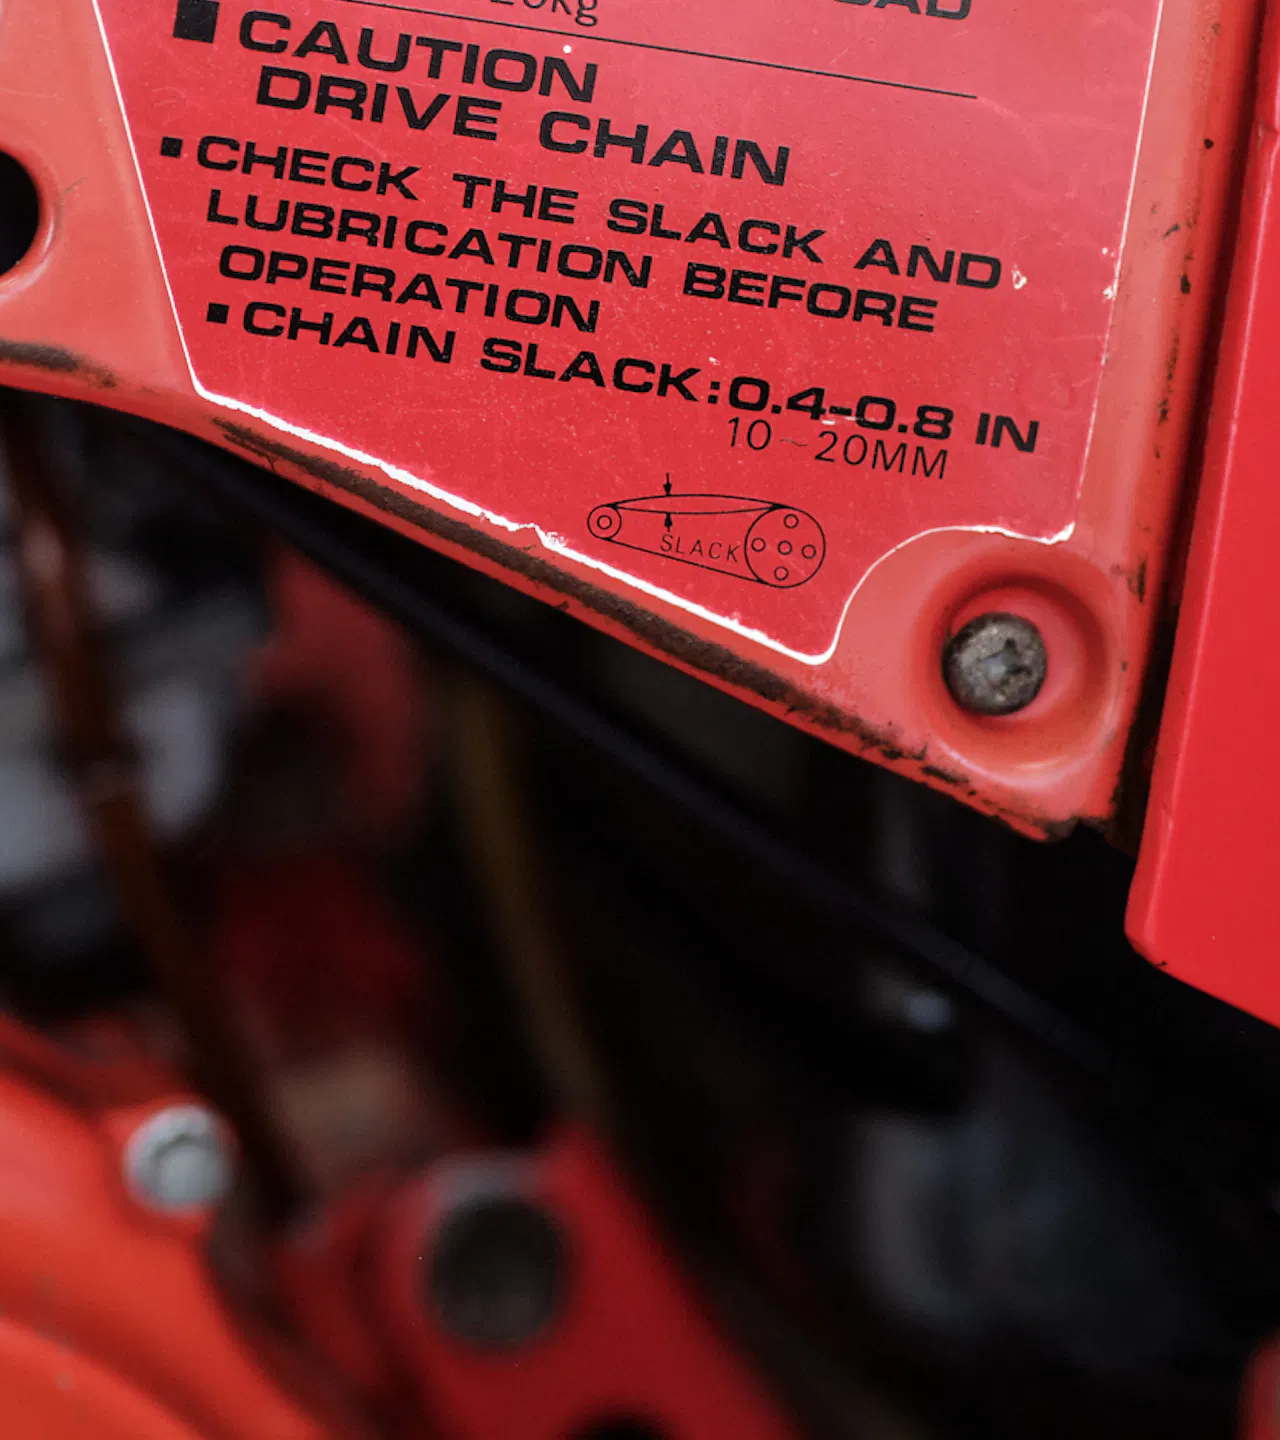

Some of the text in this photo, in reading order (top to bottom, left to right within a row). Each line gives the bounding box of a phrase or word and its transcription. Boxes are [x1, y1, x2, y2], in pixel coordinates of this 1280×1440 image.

[240, 10, 598, 103] CAUTION
[256, 65, 790, 186] DRIVE CHAIN
[197, 136, 1002, 289] CHECK THE SLACK AND
[207, 189, 938, 333] LUBRICATION BEFORE
[219, 245, 600, 333] OPERATION
[243, 302, 456, 364] CHAIN
[975, 412, 1040, 453] IN
[660, 534, 739, 562] SLACK
